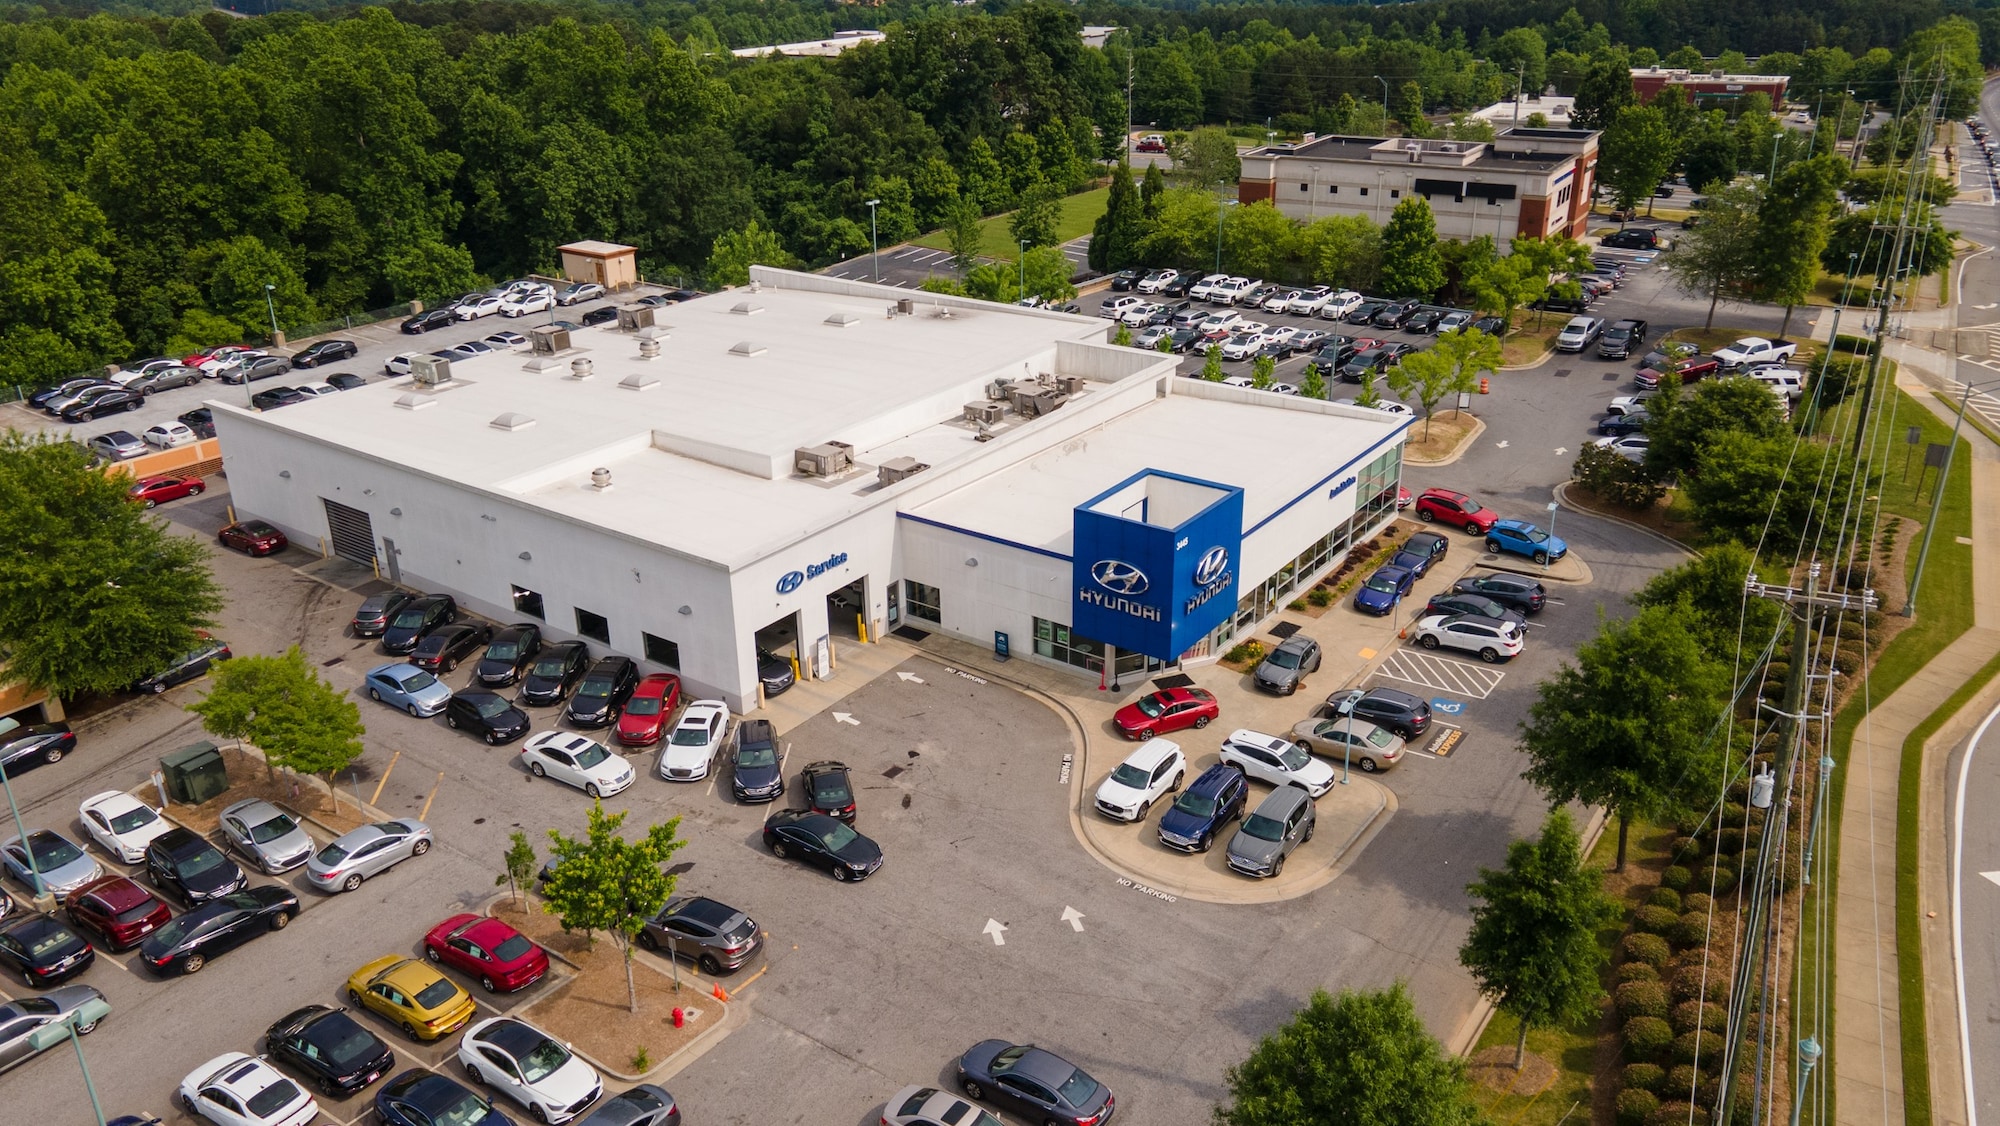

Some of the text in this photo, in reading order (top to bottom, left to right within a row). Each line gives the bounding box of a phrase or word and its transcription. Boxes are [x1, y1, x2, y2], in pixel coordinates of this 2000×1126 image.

[806, 552, 848, 581] Service
[1079, 586, 1161, 622] HYUNDAI
[1186, 570, 1232, 615] HYUNDAI
[956, 671, 988, 685] PARKING
[1436, 730, 1463, 756] EXPRESS
[1059, 753, 1072, 784] NO PARKING
[1116, 877, 1177, 903] NO PARKING
